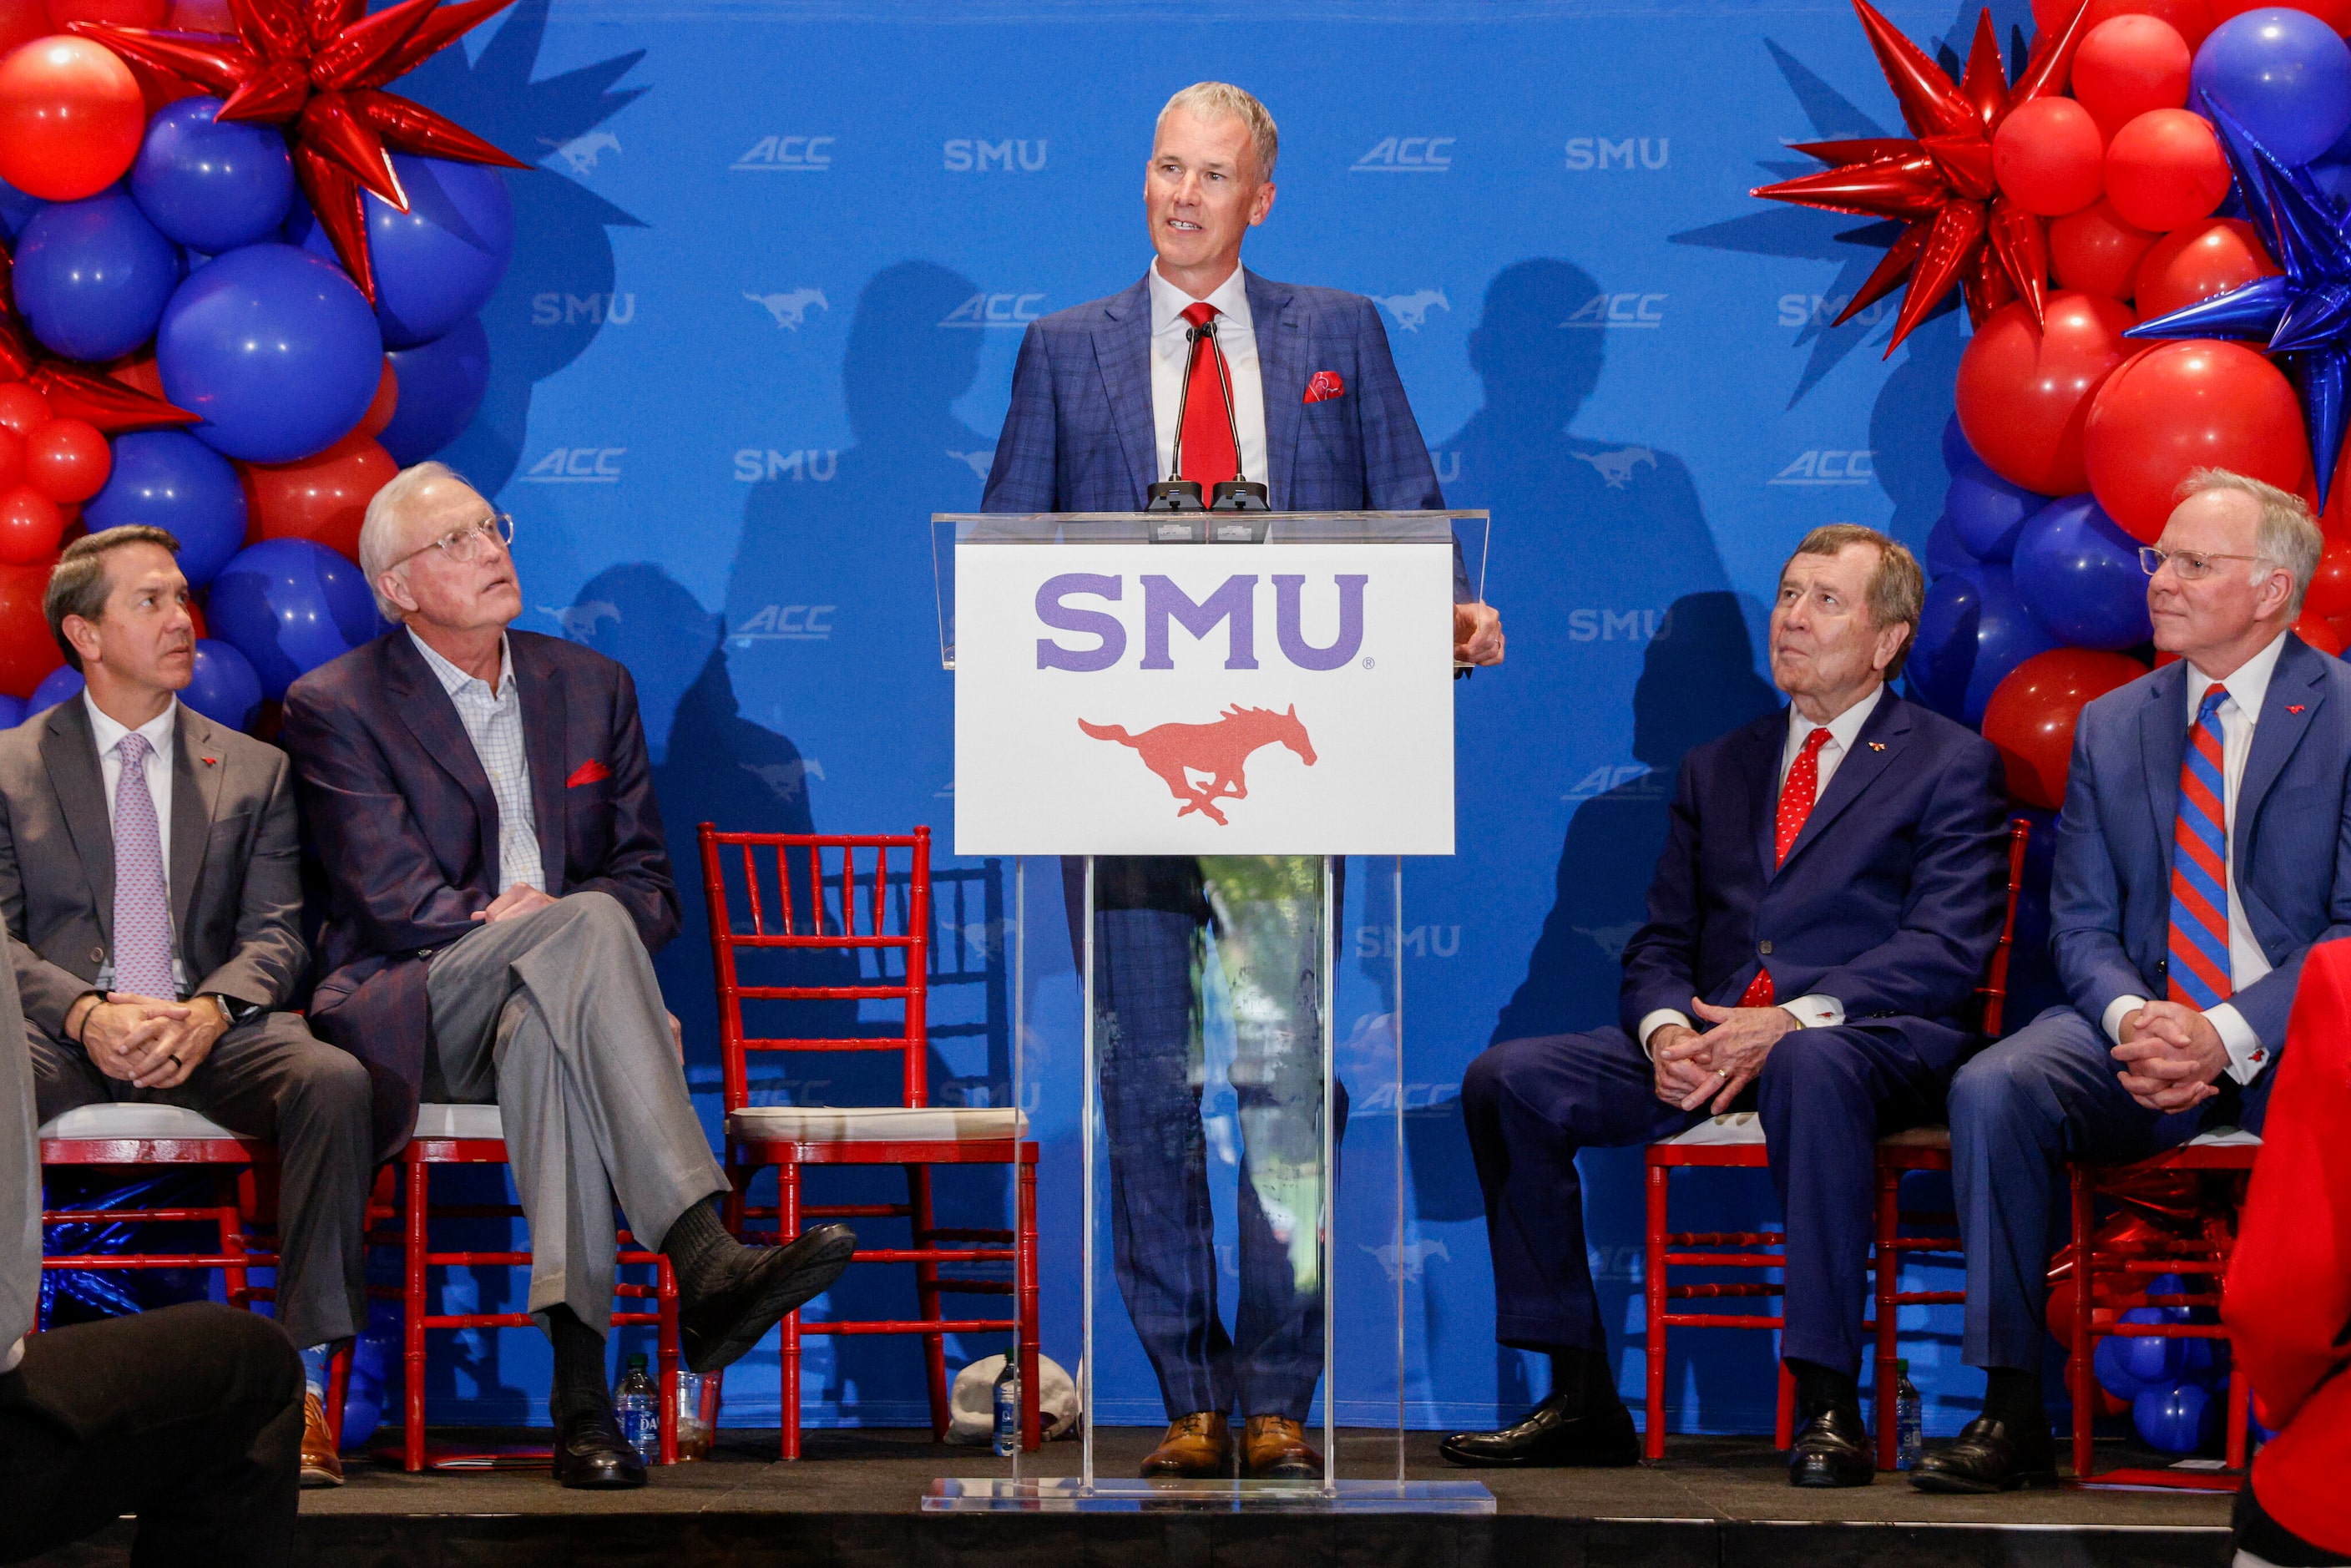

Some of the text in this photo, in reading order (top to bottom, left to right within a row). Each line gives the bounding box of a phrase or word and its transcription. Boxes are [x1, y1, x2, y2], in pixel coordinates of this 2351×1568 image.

[737, 136, 834, 163] ACC
[943, 139, 1047, 170] SMU
[1358, 137, 1457, 164] ACC
[1564, 138, 1669, 169] SMU
[532, 292, 635, 324] SMU
[946, 293, 1047, 321] ACC
[1568, 293, 1668, 320] ACC
[1778, 294, 1883, 326] SMU
[528, 447, 627, 474] ACC
[734, 448, 837, 481] SMU
[1777, 450, 1878, 477] ACC
[741, 605, 837, 632] ACC
[1035, 573, 1369, 672] SMU
[1569, 609, 1674, 640] SMU
[1570, 766, 1670, 792] ACC
[1354, 924, 1461, 958] SMU
[1358, 1083, 1459, 1109] ACC
